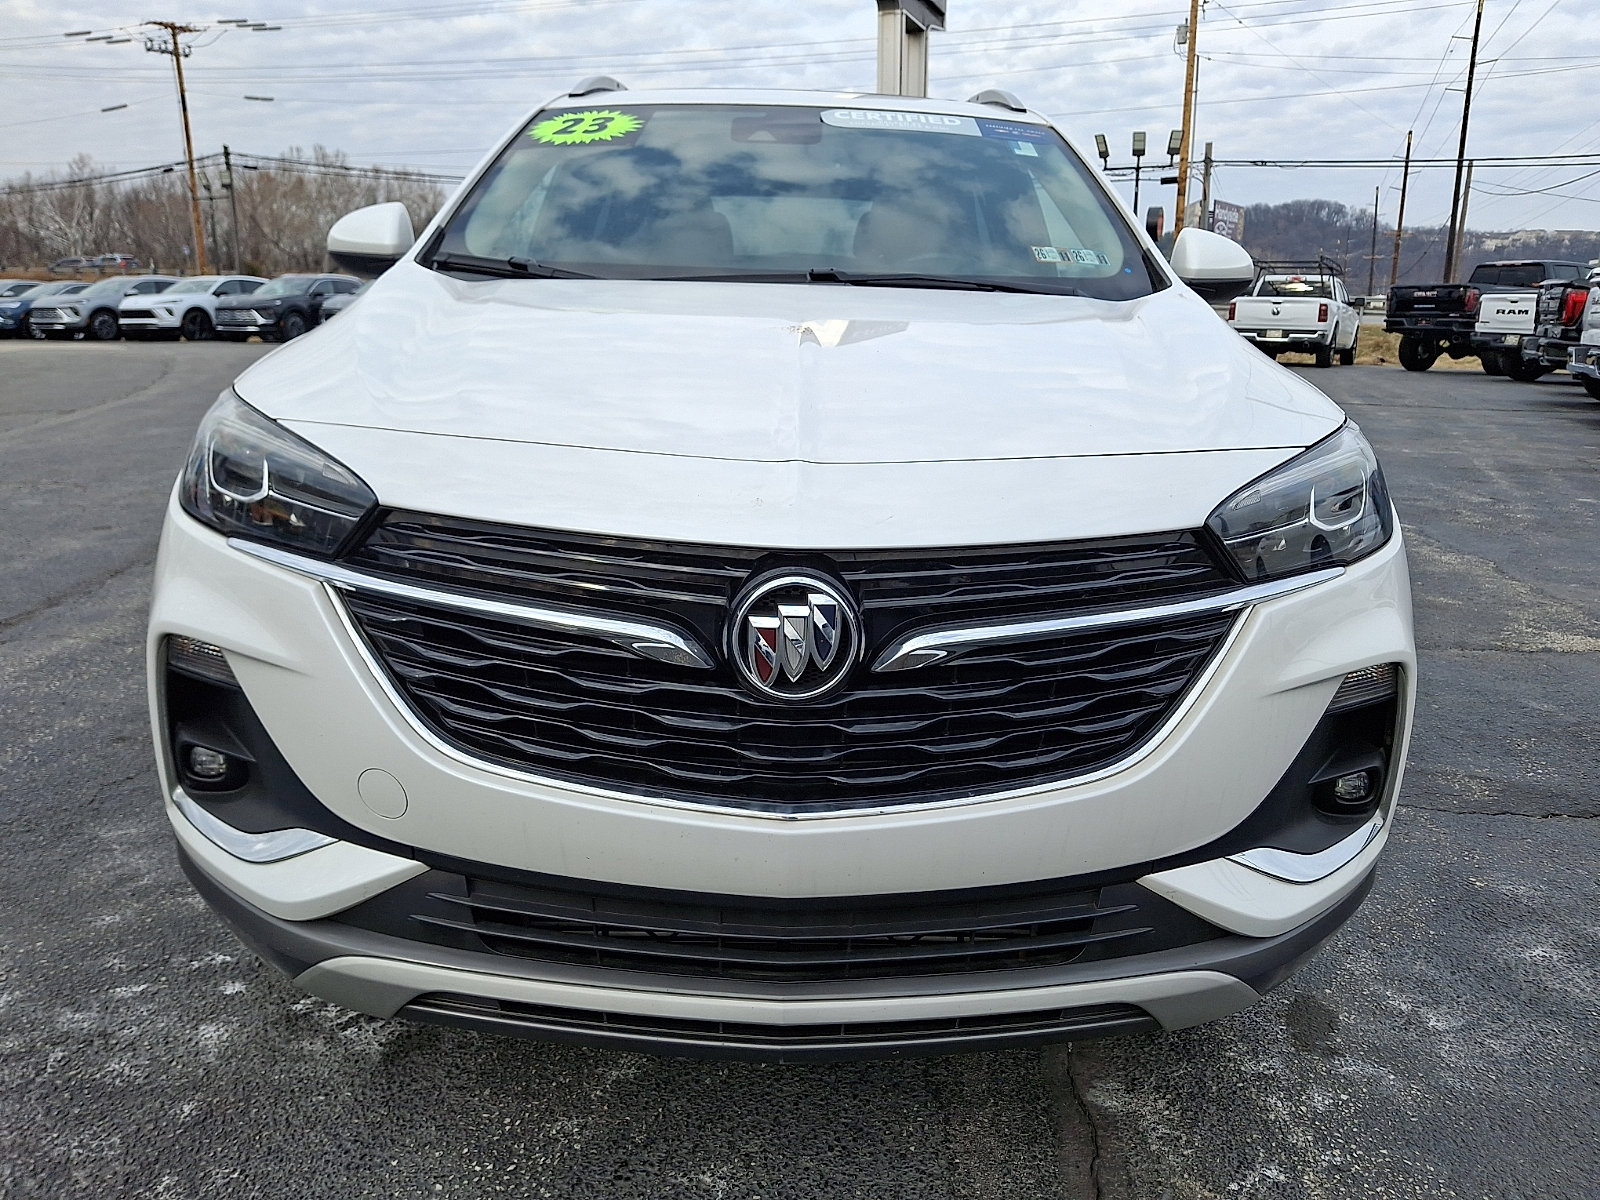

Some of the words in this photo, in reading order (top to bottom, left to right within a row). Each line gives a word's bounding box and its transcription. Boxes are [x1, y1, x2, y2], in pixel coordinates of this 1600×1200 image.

[552, 116, 615, 136] 23
[833, 110, 961, 126] CERTIFIED
[1034, 249, 1047, 260] 26
